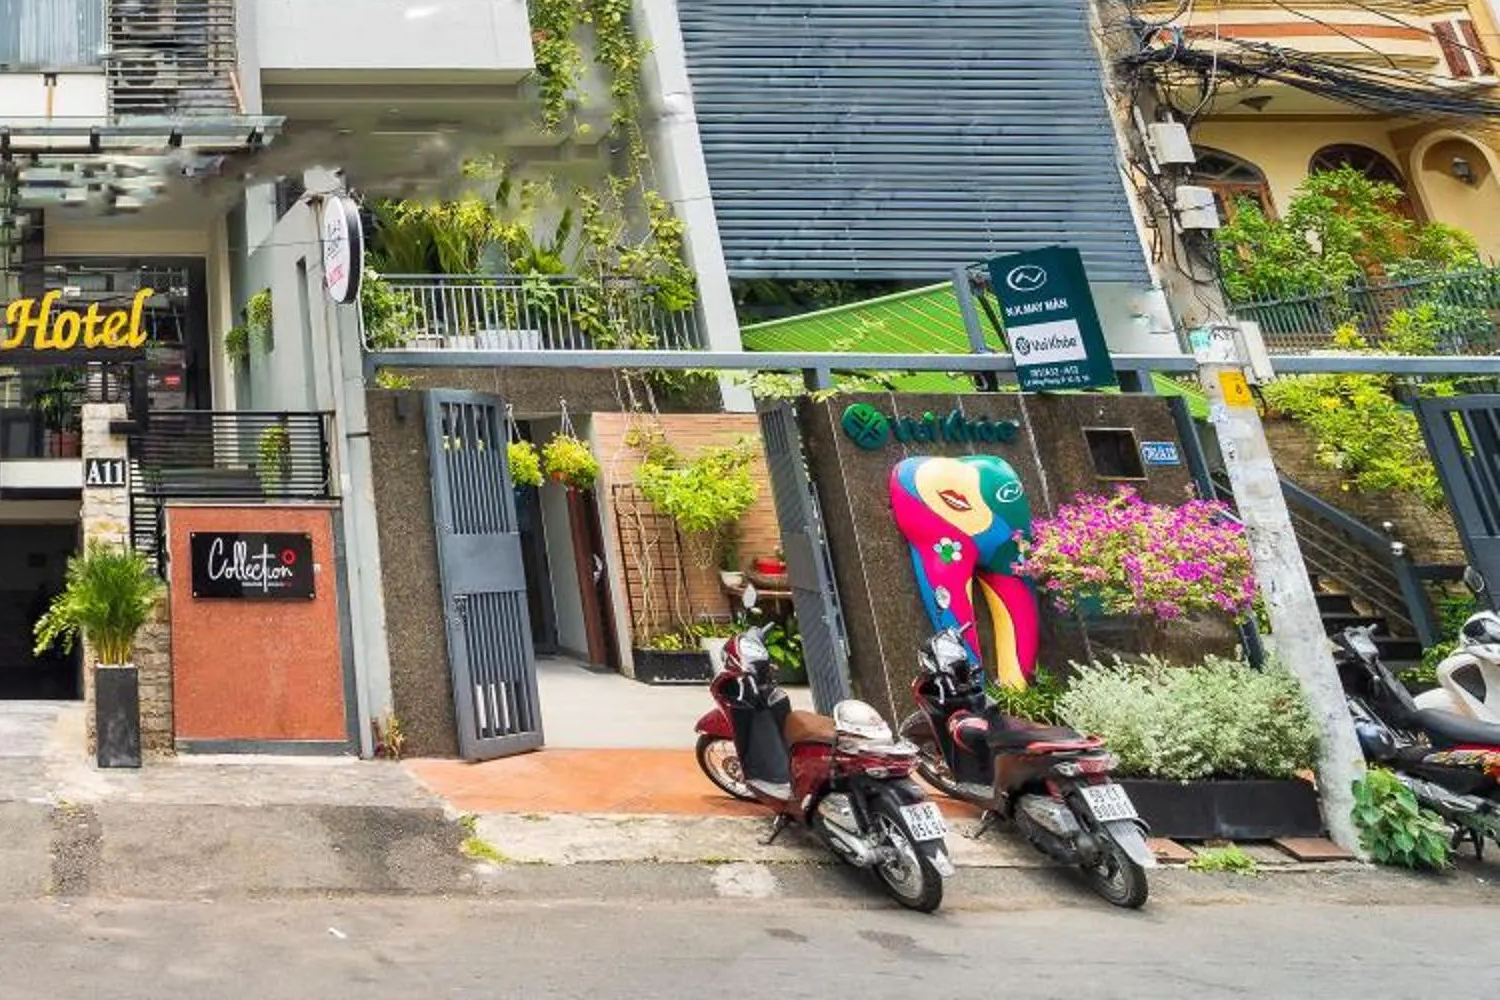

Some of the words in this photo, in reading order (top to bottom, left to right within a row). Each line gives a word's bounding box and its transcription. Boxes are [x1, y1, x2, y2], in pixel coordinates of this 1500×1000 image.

[3, 287, 155, 351] Hotel
[87, 458, 125, 485] A11
[208, 537, 297, 593] Collection
